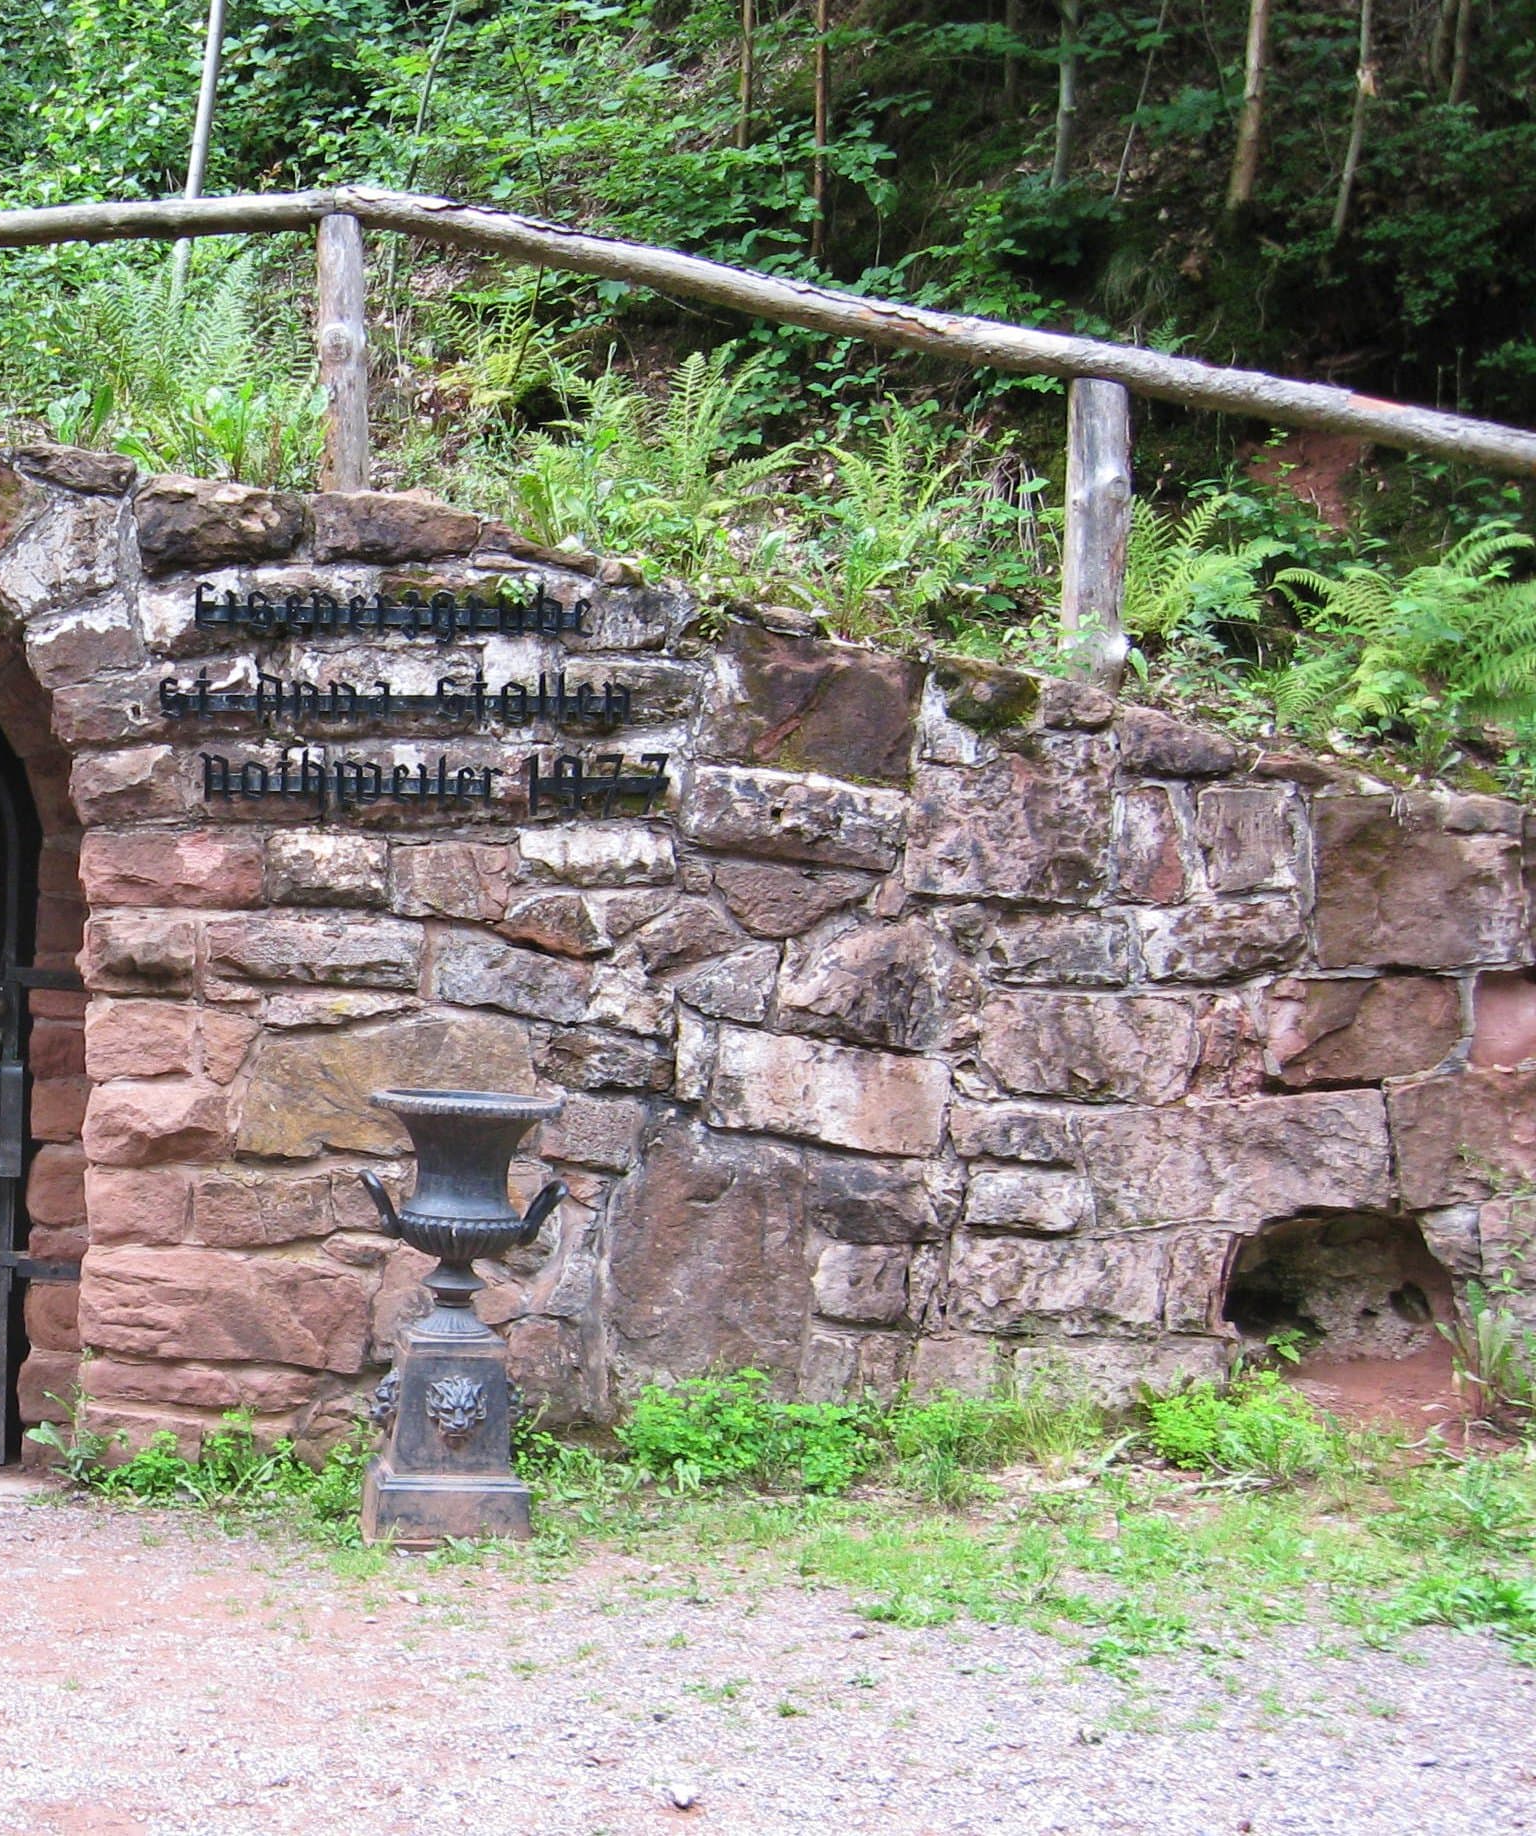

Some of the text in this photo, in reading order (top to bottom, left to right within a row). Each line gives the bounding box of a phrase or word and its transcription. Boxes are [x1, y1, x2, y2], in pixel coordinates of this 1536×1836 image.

[256, 669, 391, 724] Anna
[436, 668, 632, 725] Stollen
[198, 748, 671, 818] Nothweiler 1977
